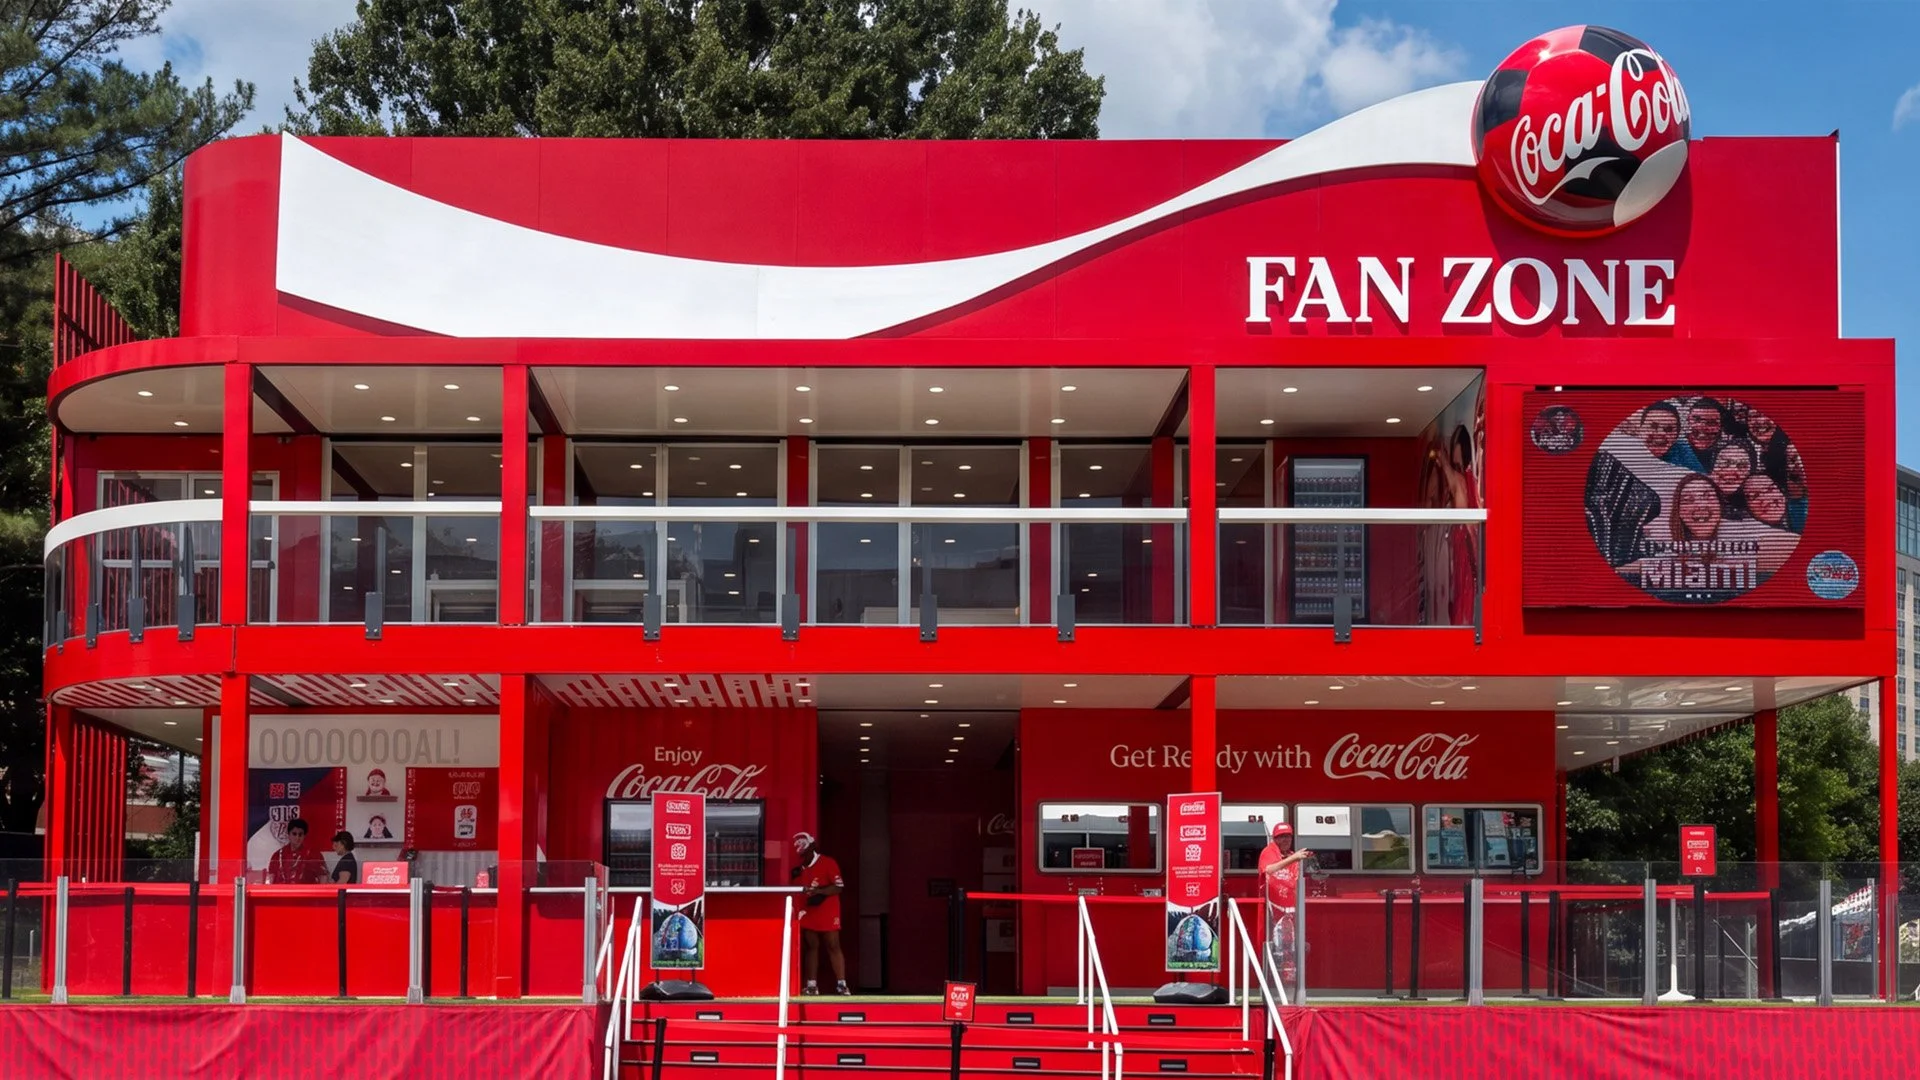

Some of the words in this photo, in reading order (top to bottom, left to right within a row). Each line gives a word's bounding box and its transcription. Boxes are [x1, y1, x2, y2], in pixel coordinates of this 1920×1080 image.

[1510, 48, 1690, 206] Coca-Cola
[1246, 256, 1415, 323] FAN
[1441, 257, 1676, 326] ZONE
[1641, 559, 1757, 589] Miami
[654, 746, 703, 766] Enjoy
[1110, 744, 1156, 768] Get
[1162, 744, 1249, 774] Redy
[1253, 744, 1312, 769] with
[1323, 732, 1480, 781] Coca-Cola
